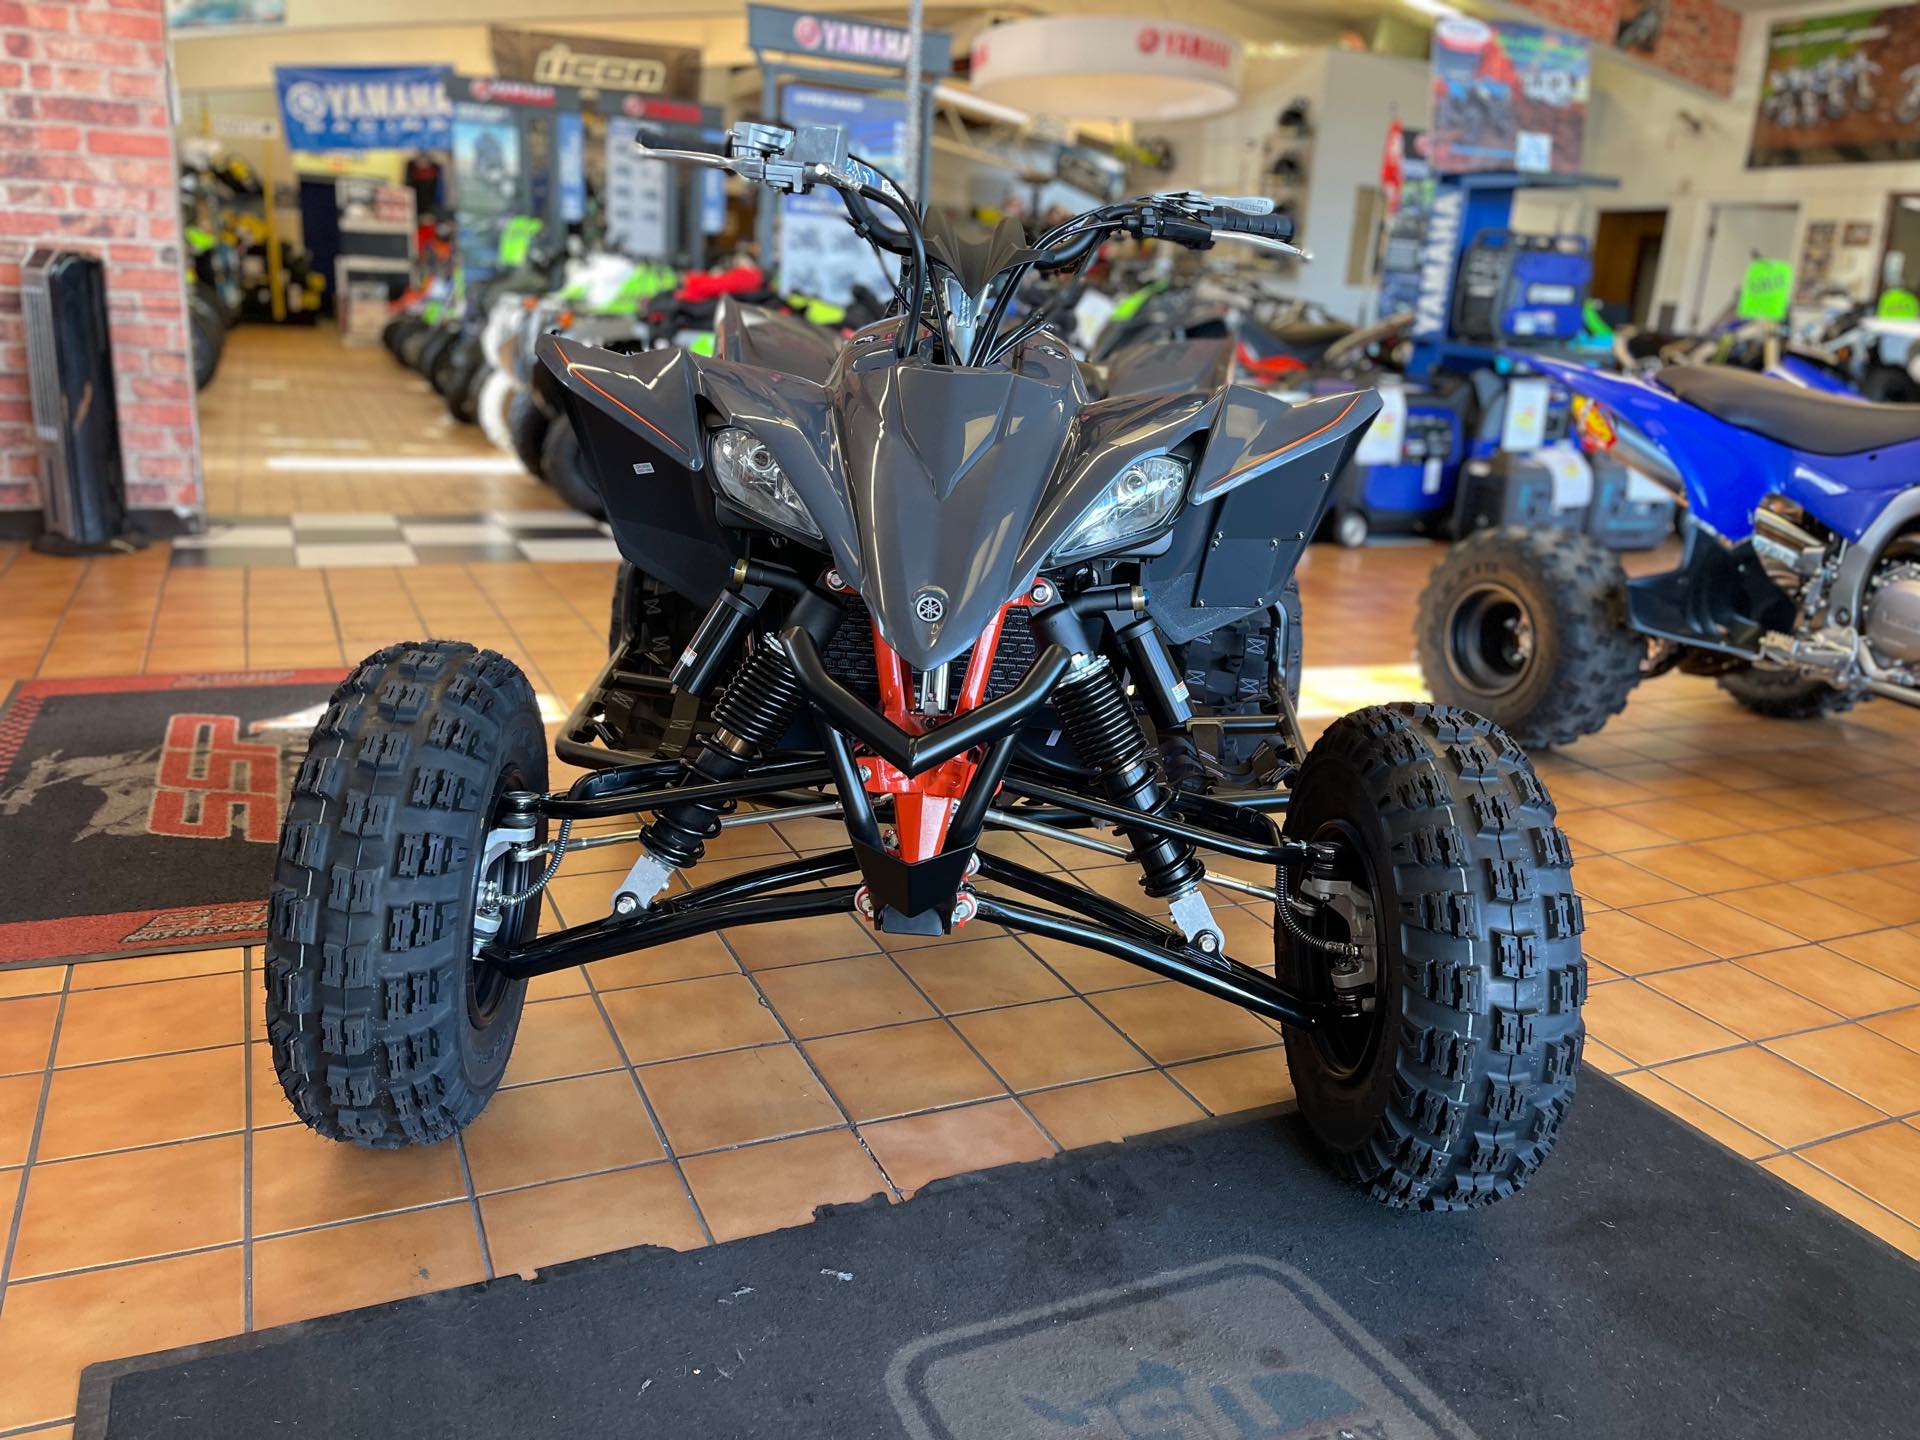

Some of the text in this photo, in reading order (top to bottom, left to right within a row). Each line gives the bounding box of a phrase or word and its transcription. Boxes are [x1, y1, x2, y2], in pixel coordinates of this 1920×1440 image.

[534, 44, 666, 93] icon
[325, 82, 453, 118] YAMAHA
[1411, 191, 1463, 336] YAMAHA
